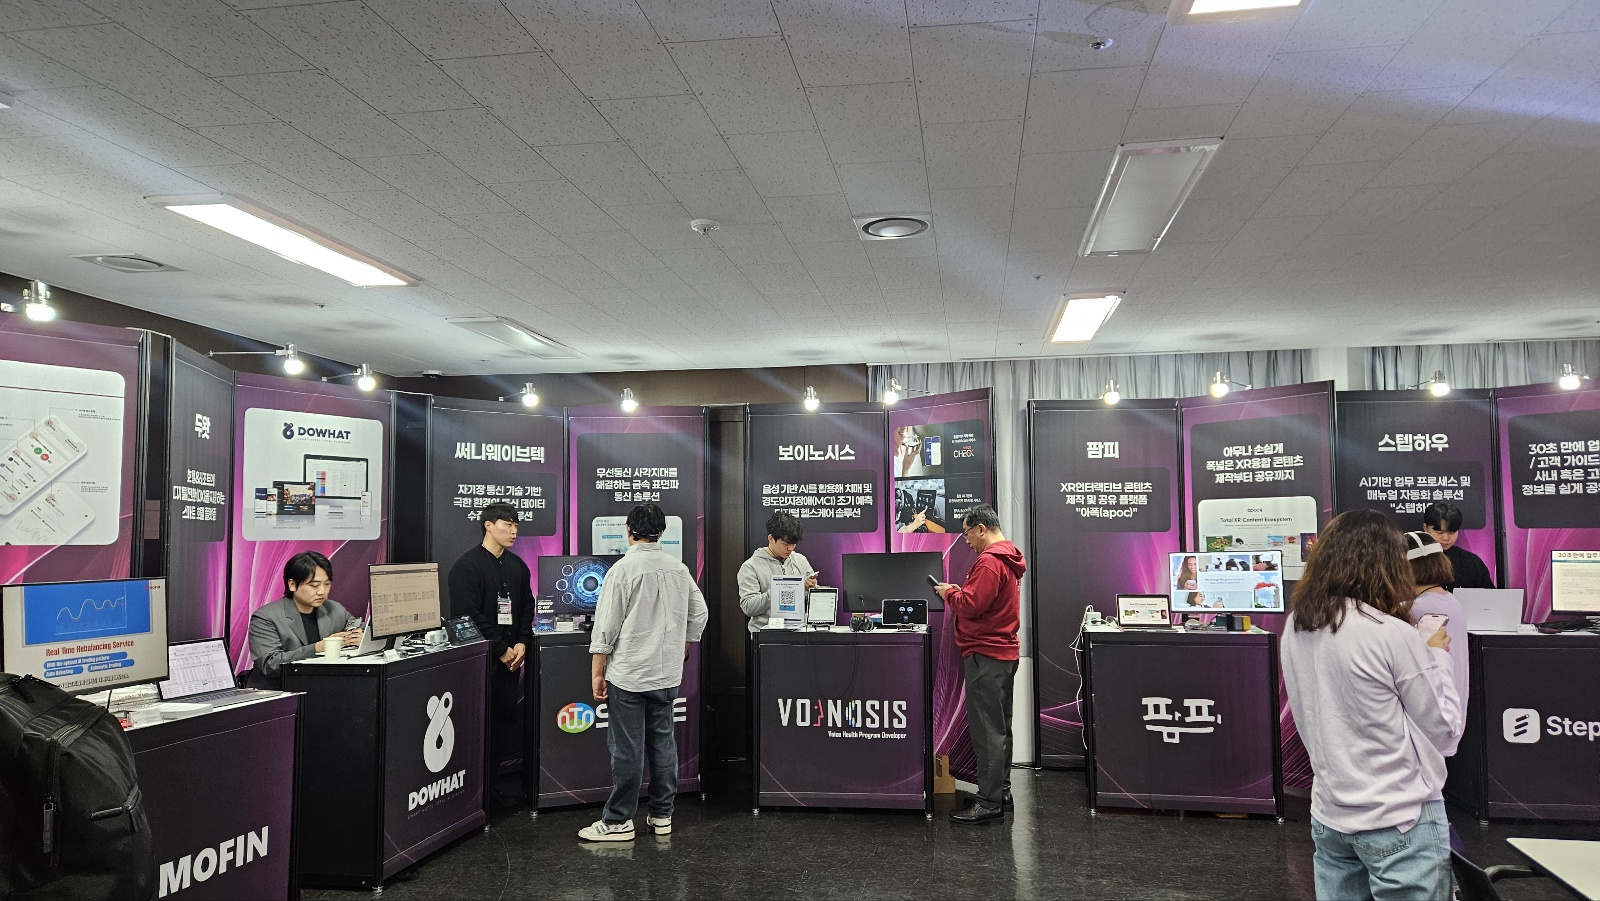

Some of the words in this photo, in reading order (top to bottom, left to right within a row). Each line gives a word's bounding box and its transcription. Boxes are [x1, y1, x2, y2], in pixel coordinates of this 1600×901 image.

[195, 413, 211, 440] 두왓
[298, 426, 352, 440] DOWHAT
[1378, 433, 1449, 452] 스텝하우
[1528, 442, 1558, 455] 30초
[1560, 440, 1585, 454] 만에
[454, 442, 545, 464] 써니웨이브텍
[778, 444, 856, 461] 보이노시스
[1086, 441, 1120, 459] 팜피
[1223, 445, 1252, 458] 아무나
[1253, 442, 1284, 456] 손쉽게
[1206, 459, 1235, 472] 폭넓은
[1235, 457, 1272, 470] XR융합
[1272, 454, 1304, 468] 콘텐츠
[1529, 456, 1535, 469] /
[1537, 455, 1561, 468] 고객
[596, 467, 632, 478] 무선통신
[633, 467, 678, 478] 사각지대를
[1214, 472, 1253, 484] 제작부터
[1254, 469, 1295, 482] 공유까지
[1534, 469, 1558, 482] 사내
[1559, 468, 1584, 481] 혹은
[1587, 468, 1600, 480] 고
[595, 480, 631, 490] 해결하는
[632, 480, 650, 490] 금속
[651, 479, 679, 490] 표면파
[762, 484, 780, 494] 음성
[780, 484, 799, 494] 기반
[799, 484, 817, 494] AI를
[817, 483, 844, 494] 활용해
[844, 483, 863, 494] 치매
[863, 483, 873, 494] 및
[1060, 482, 1123, 493] XR인터랙티브
[1123, 482, 1153, 493] 콘텐츠
[1359, 476, 1392, 487] AI기반
[1394, 476, 1415, 487] 업무
[1416, 476, 1458, 487] 프로세스
[1459, 476, 1471, 487] 및
[457, 484, 486, 495] 자기장
[486, 484, 504, 496] 통신
[505, 485, 524, 496] 기술
[524, 486, 543, 497] 기반
[1367, 489, 1398, 501] 매뉴얼
[1399, 489, 1431, 501] 자동화
[1432, 489, 1464, 501] 솔루션
[1521, 483, 1556, 496] 정보를
[1558, 482, 1584, 495] 쉽게
[1585, 482, 1600, 494] 공
[452, 497, 473, 508] 극한
[520, 499, 546, 509] 데이터
[614, 491, 631, 502] 통신
[633, 491, 660, 502] 솔루션
[762, 496, 836, 507] 경도인지장애(MCI)
[836, 496, 855, 506] 조기
[855, 495, 873, 506] 예측
[1065, 494, 1085, 505] 제작
[1086, 494, 1097, 505] 및
[1098, 494, 1118, 505] 공유
[1119, 494, 1148, 505] 플랫폼
[800, 508, 835, 518] 헬스케어
[835, 508, 861, 518] 솔루션
[1390, 503, 1434, 514] "스텝하
[45, 648, 60, 657] Real
[61, 646, 75, 655] Time
[76, 643, 112, 654] Rebalancing
[112, 640, 135, 650] Service
[859, 731, 880, 740] Program
[881, 732, 907, 740] Developer
[408, 769, 466, 812] DOWHAT
[158, 825, 269, 899] MOFIN
